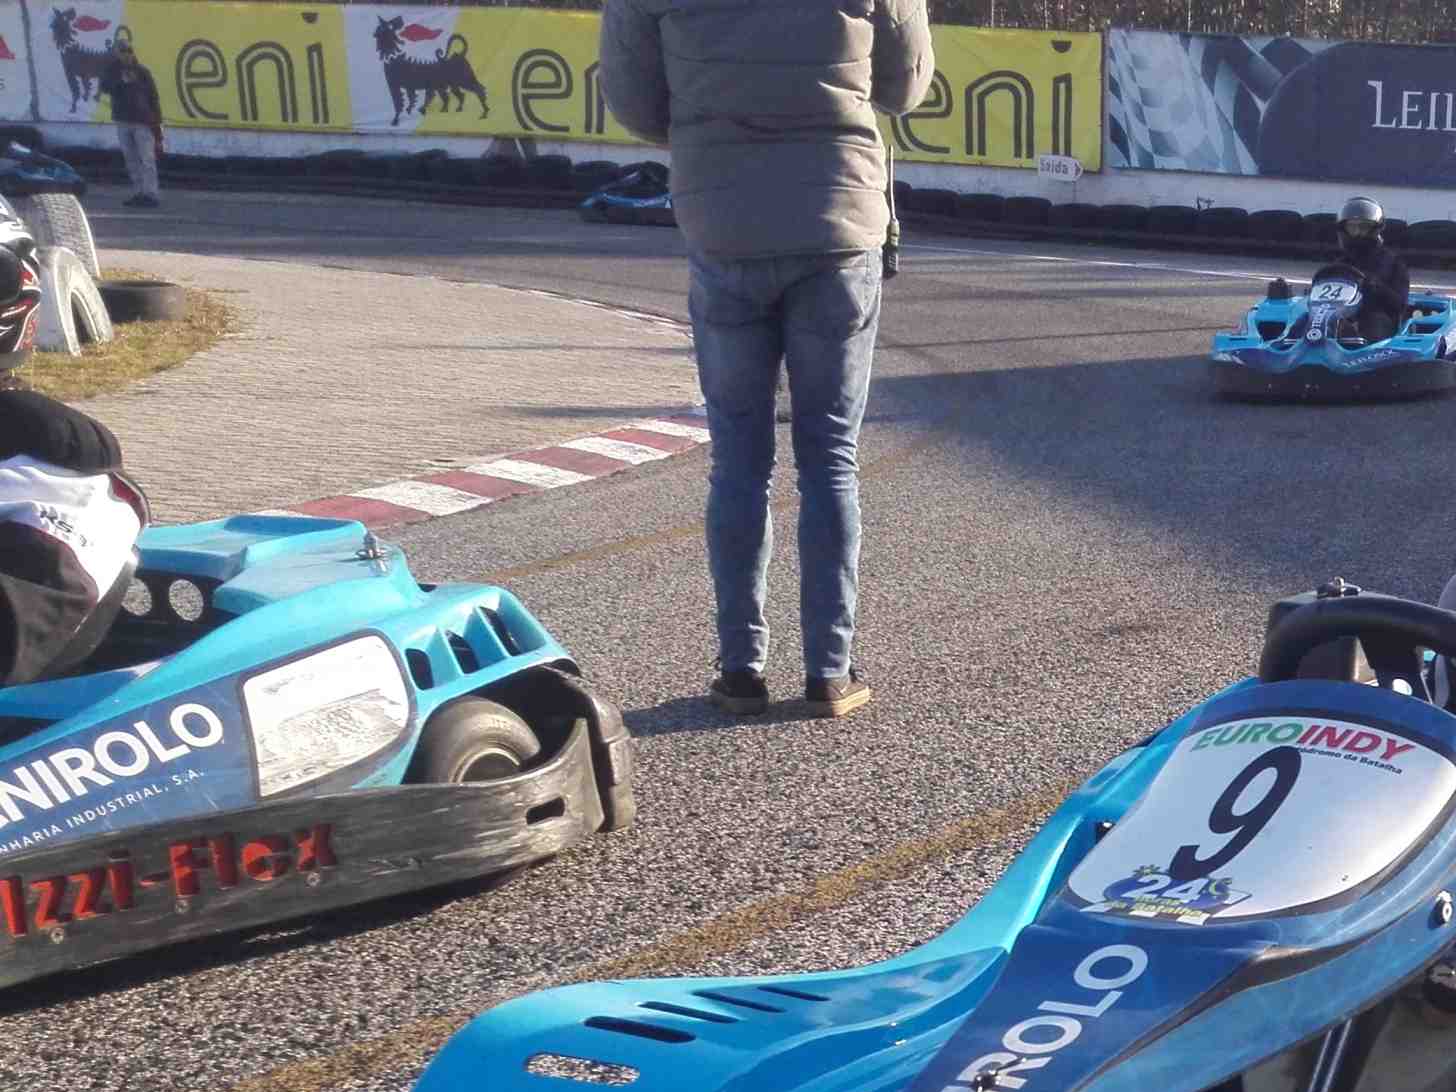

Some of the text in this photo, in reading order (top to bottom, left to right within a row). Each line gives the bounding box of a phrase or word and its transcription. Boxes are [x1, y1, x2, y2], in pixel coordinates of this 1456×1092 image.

[175, 12, 329, 125] eni
[890, 40, 1072, 158] eni
[1319, 284, 1344, 299] 24
[0, 703, 225, 828] NIROLO
[172, 768, 205, 786] S.A.
[1359, 756, 1402, 774] Batalha
[1169, 745, 1302, 881] 9
[1121, 874, 1210, 904] 24
